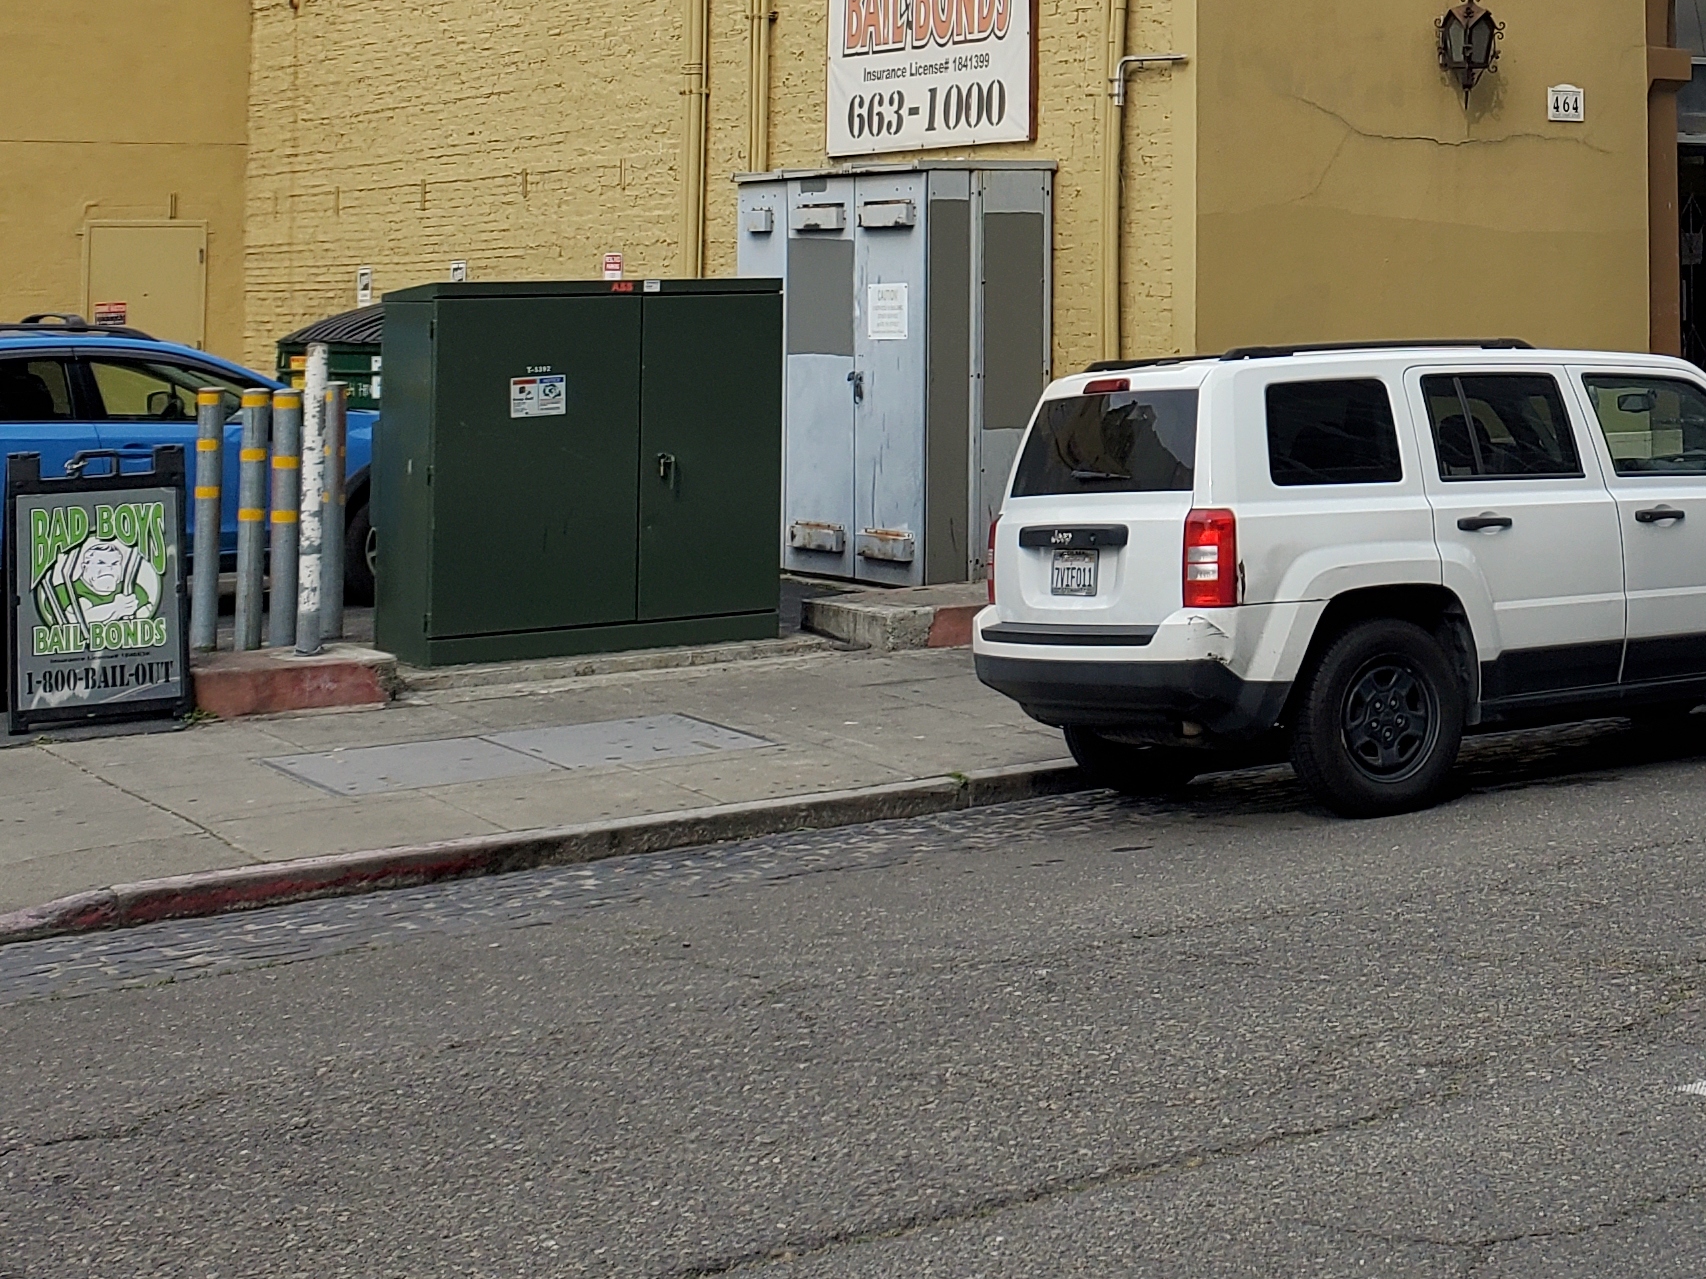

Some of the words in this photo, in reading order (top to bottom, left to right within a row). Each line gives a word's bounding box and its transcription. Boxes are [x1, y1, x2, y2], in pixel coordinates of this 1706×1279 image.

[863, 66, 908, 82] Insurance
[909, 58, 951, 77] License#
[952, 52, 991, 72] 1841399
[847, 78, 1006, 140] 663-1000
[1552, 95, 1579, 113] 464
[30, 507, 90, 591] BAD
[95, 502, 167, 576] BOYS
[1054, 567, 1093, 588] 7VIF011
[33, 624, 87, 656] BAIL
[90, 618, 167, 651] BONDS
[26, 660, 174, 696] 1-800-BAIL-OUT
